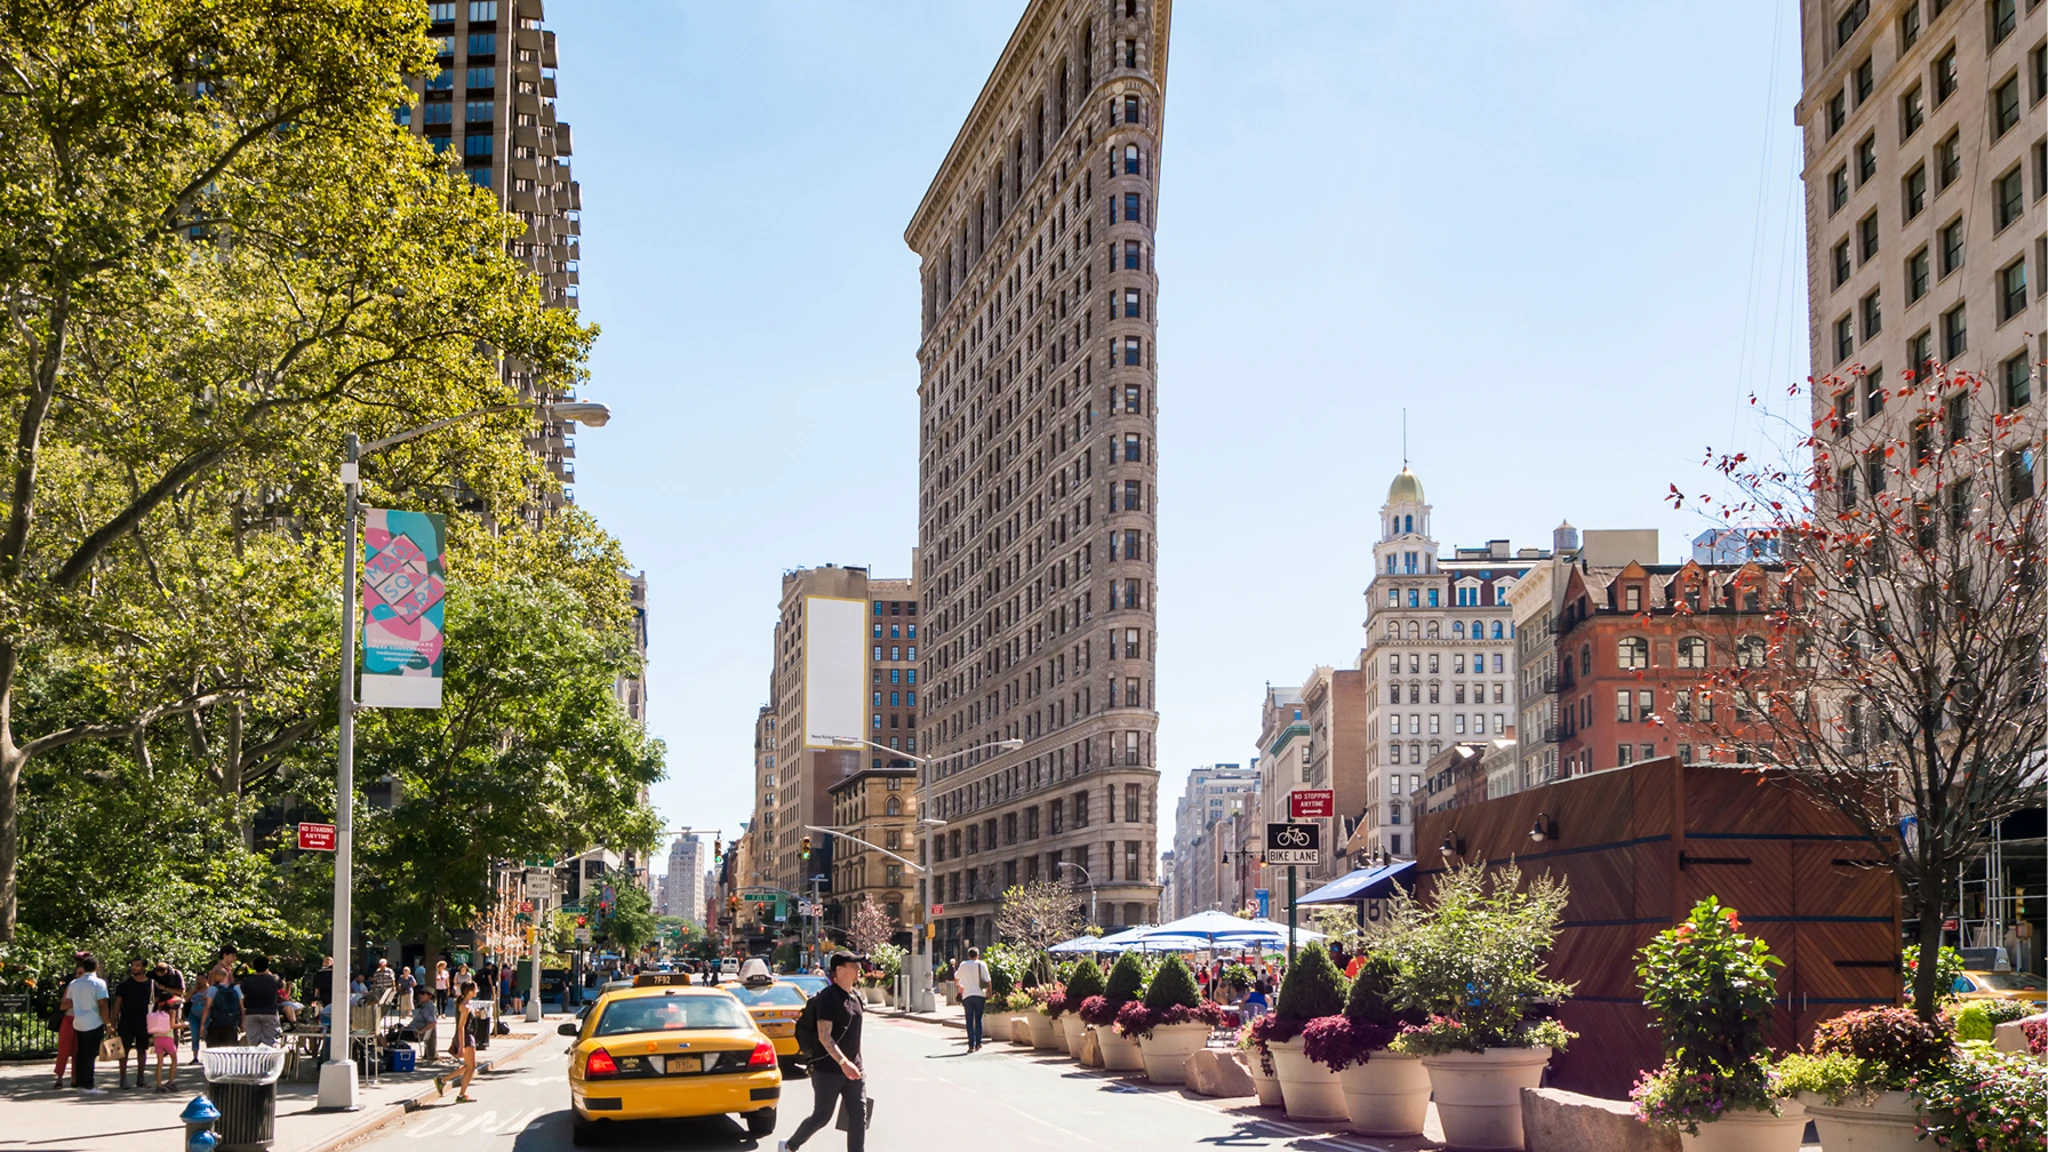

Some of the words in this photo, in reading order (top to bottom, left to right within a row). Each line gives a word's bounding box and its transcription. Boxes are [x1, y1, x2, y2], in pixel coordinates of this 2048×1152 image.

[1304, 792, 1330, 800] STOPPING
[1270, 851, 1290, 861] BIKE
[1294, 851, 1317, 861] LANE
[653, 975, 671, 984] 7F92
[403, 1107, 546, 1138] ONL
